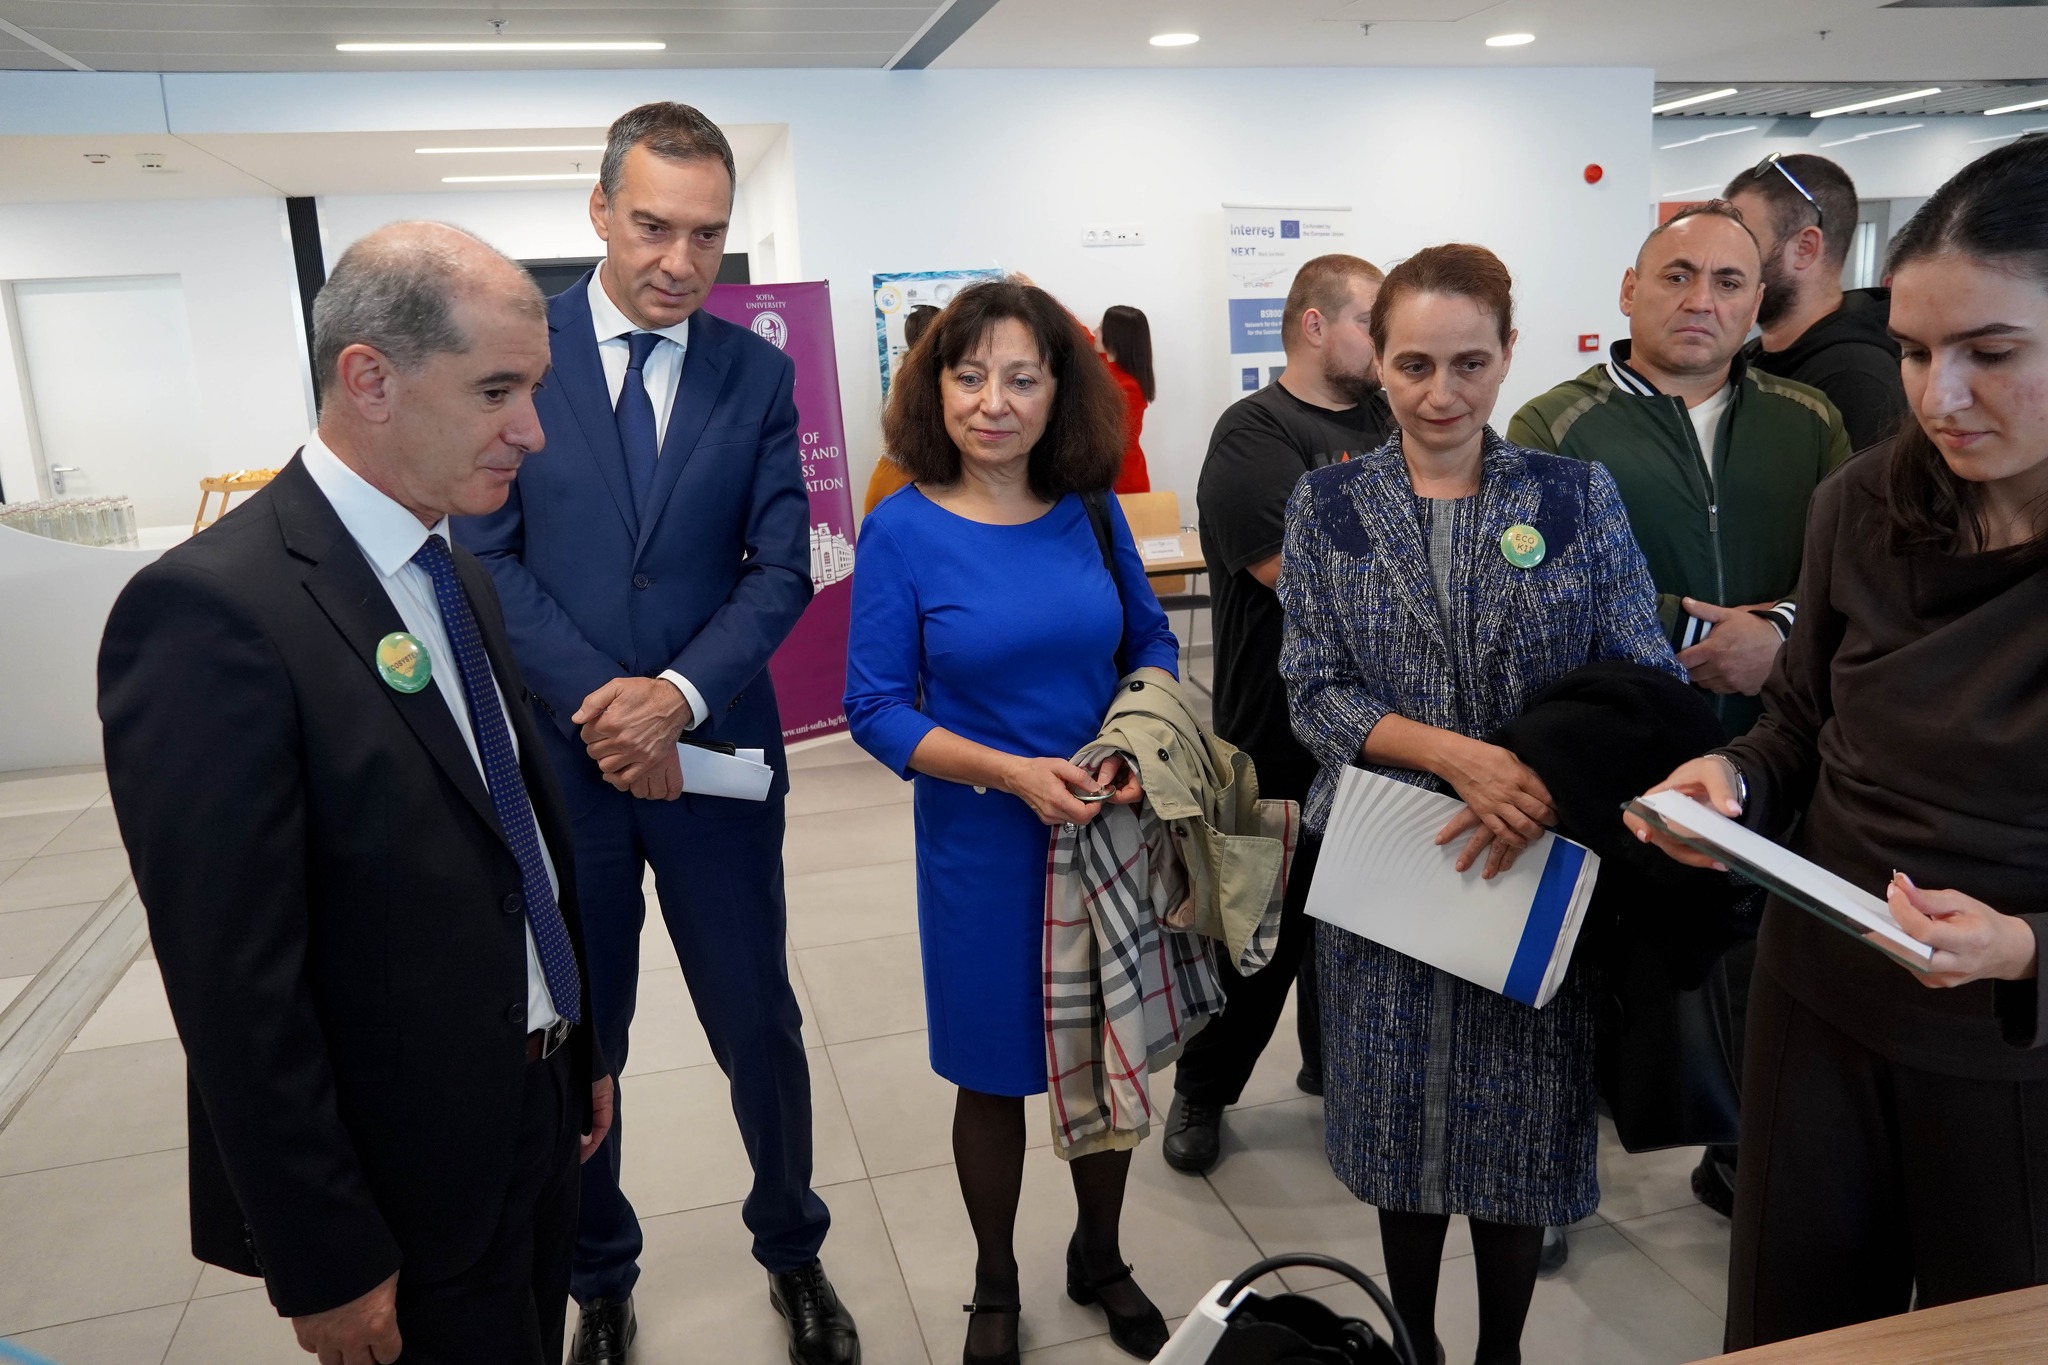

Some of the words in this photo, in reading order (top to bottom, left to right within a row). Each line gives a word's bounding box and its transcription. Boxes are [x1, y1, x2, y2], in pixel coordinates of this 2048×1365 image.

[1230, 223, 1275, 238] Interreg
[1231, 247, 1256, 256] NEXT
[755, 293, 775, 301] SOFIA
[746, 301, 786, 310] UNIVERSITY
[802, 432, 819, 445] OF
[811, 446, 839, 460] AND
[1515, 533, 1535, 544] ECO
[1516, 543, 1535, 553] KID
